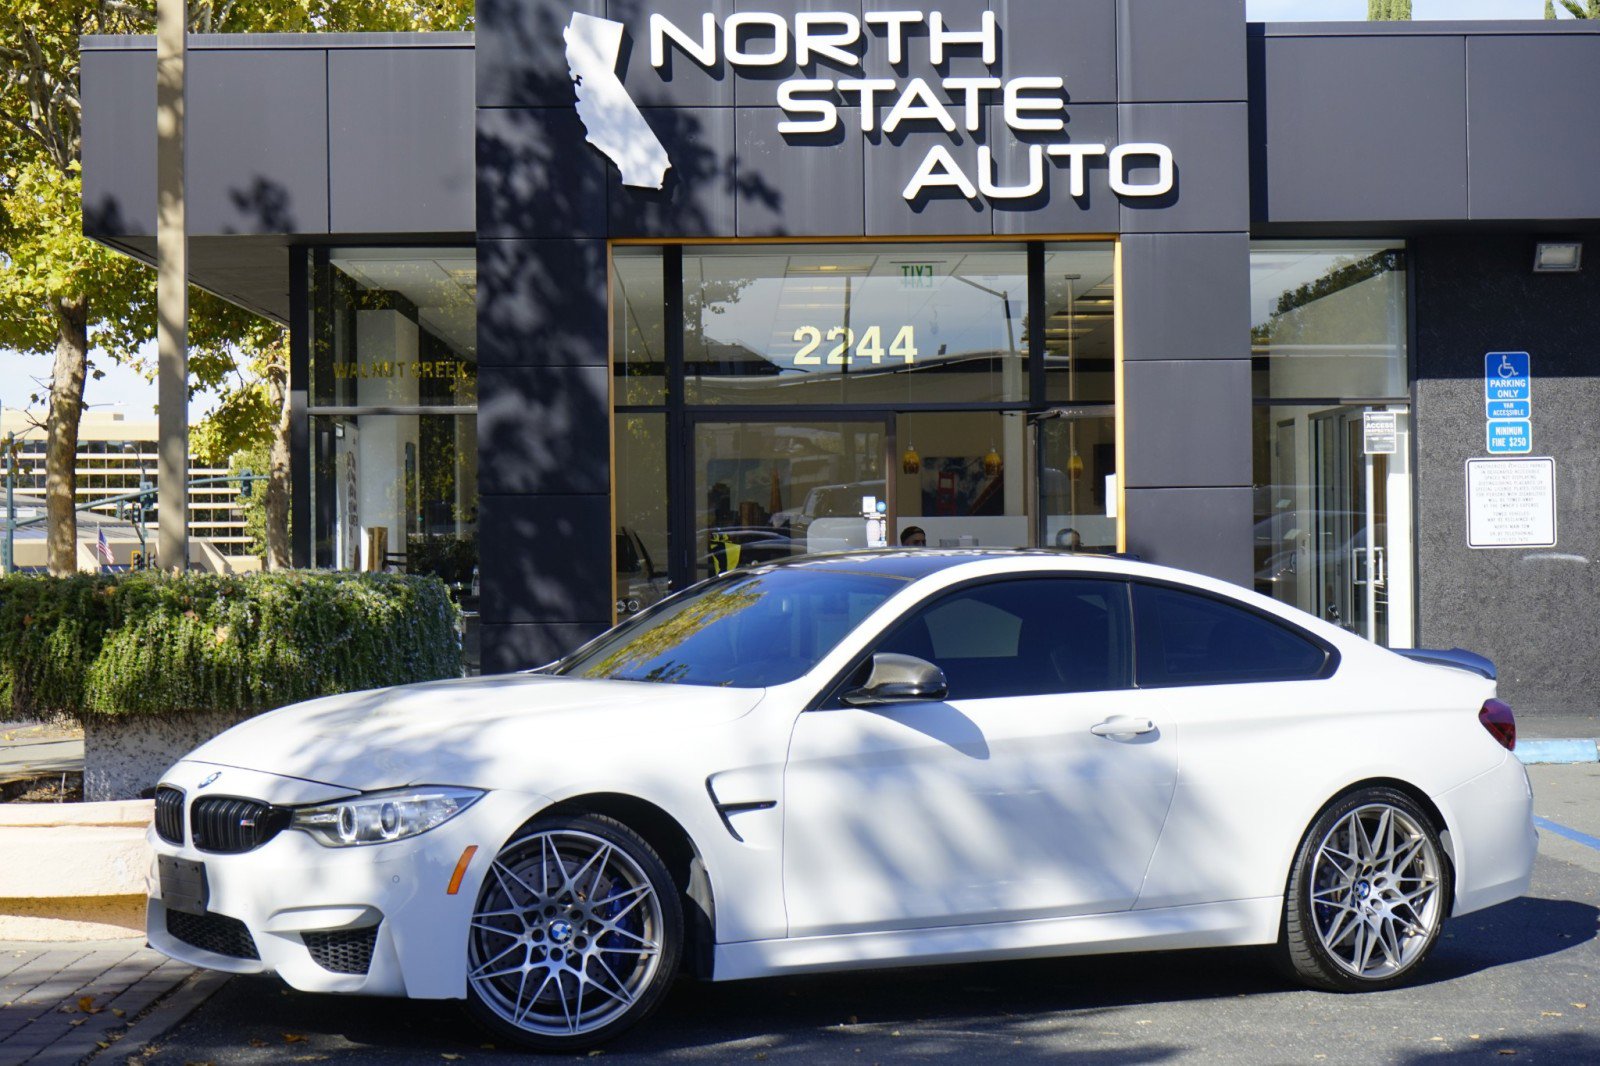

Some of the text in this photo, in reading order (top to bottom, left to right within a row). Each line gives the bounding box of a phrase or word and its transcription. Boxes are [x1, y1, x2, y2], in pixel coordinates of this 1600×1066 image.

[649, 10, 996, 68] NORTH
[777, 76, 1064, 134] STATE
[902, 143, 1174, 200] AUTO
[793, 325, 918, 365] 2244
[333, 361, 467, 379] WALNUT CREEK
[1490, 379, 1526, 388] PARKING
[1497, 389, 1519, 398] ONLY
[1495, 426, 1523, 436] MINIMUM
[1491, 437, 1527, 448] FINE $250
